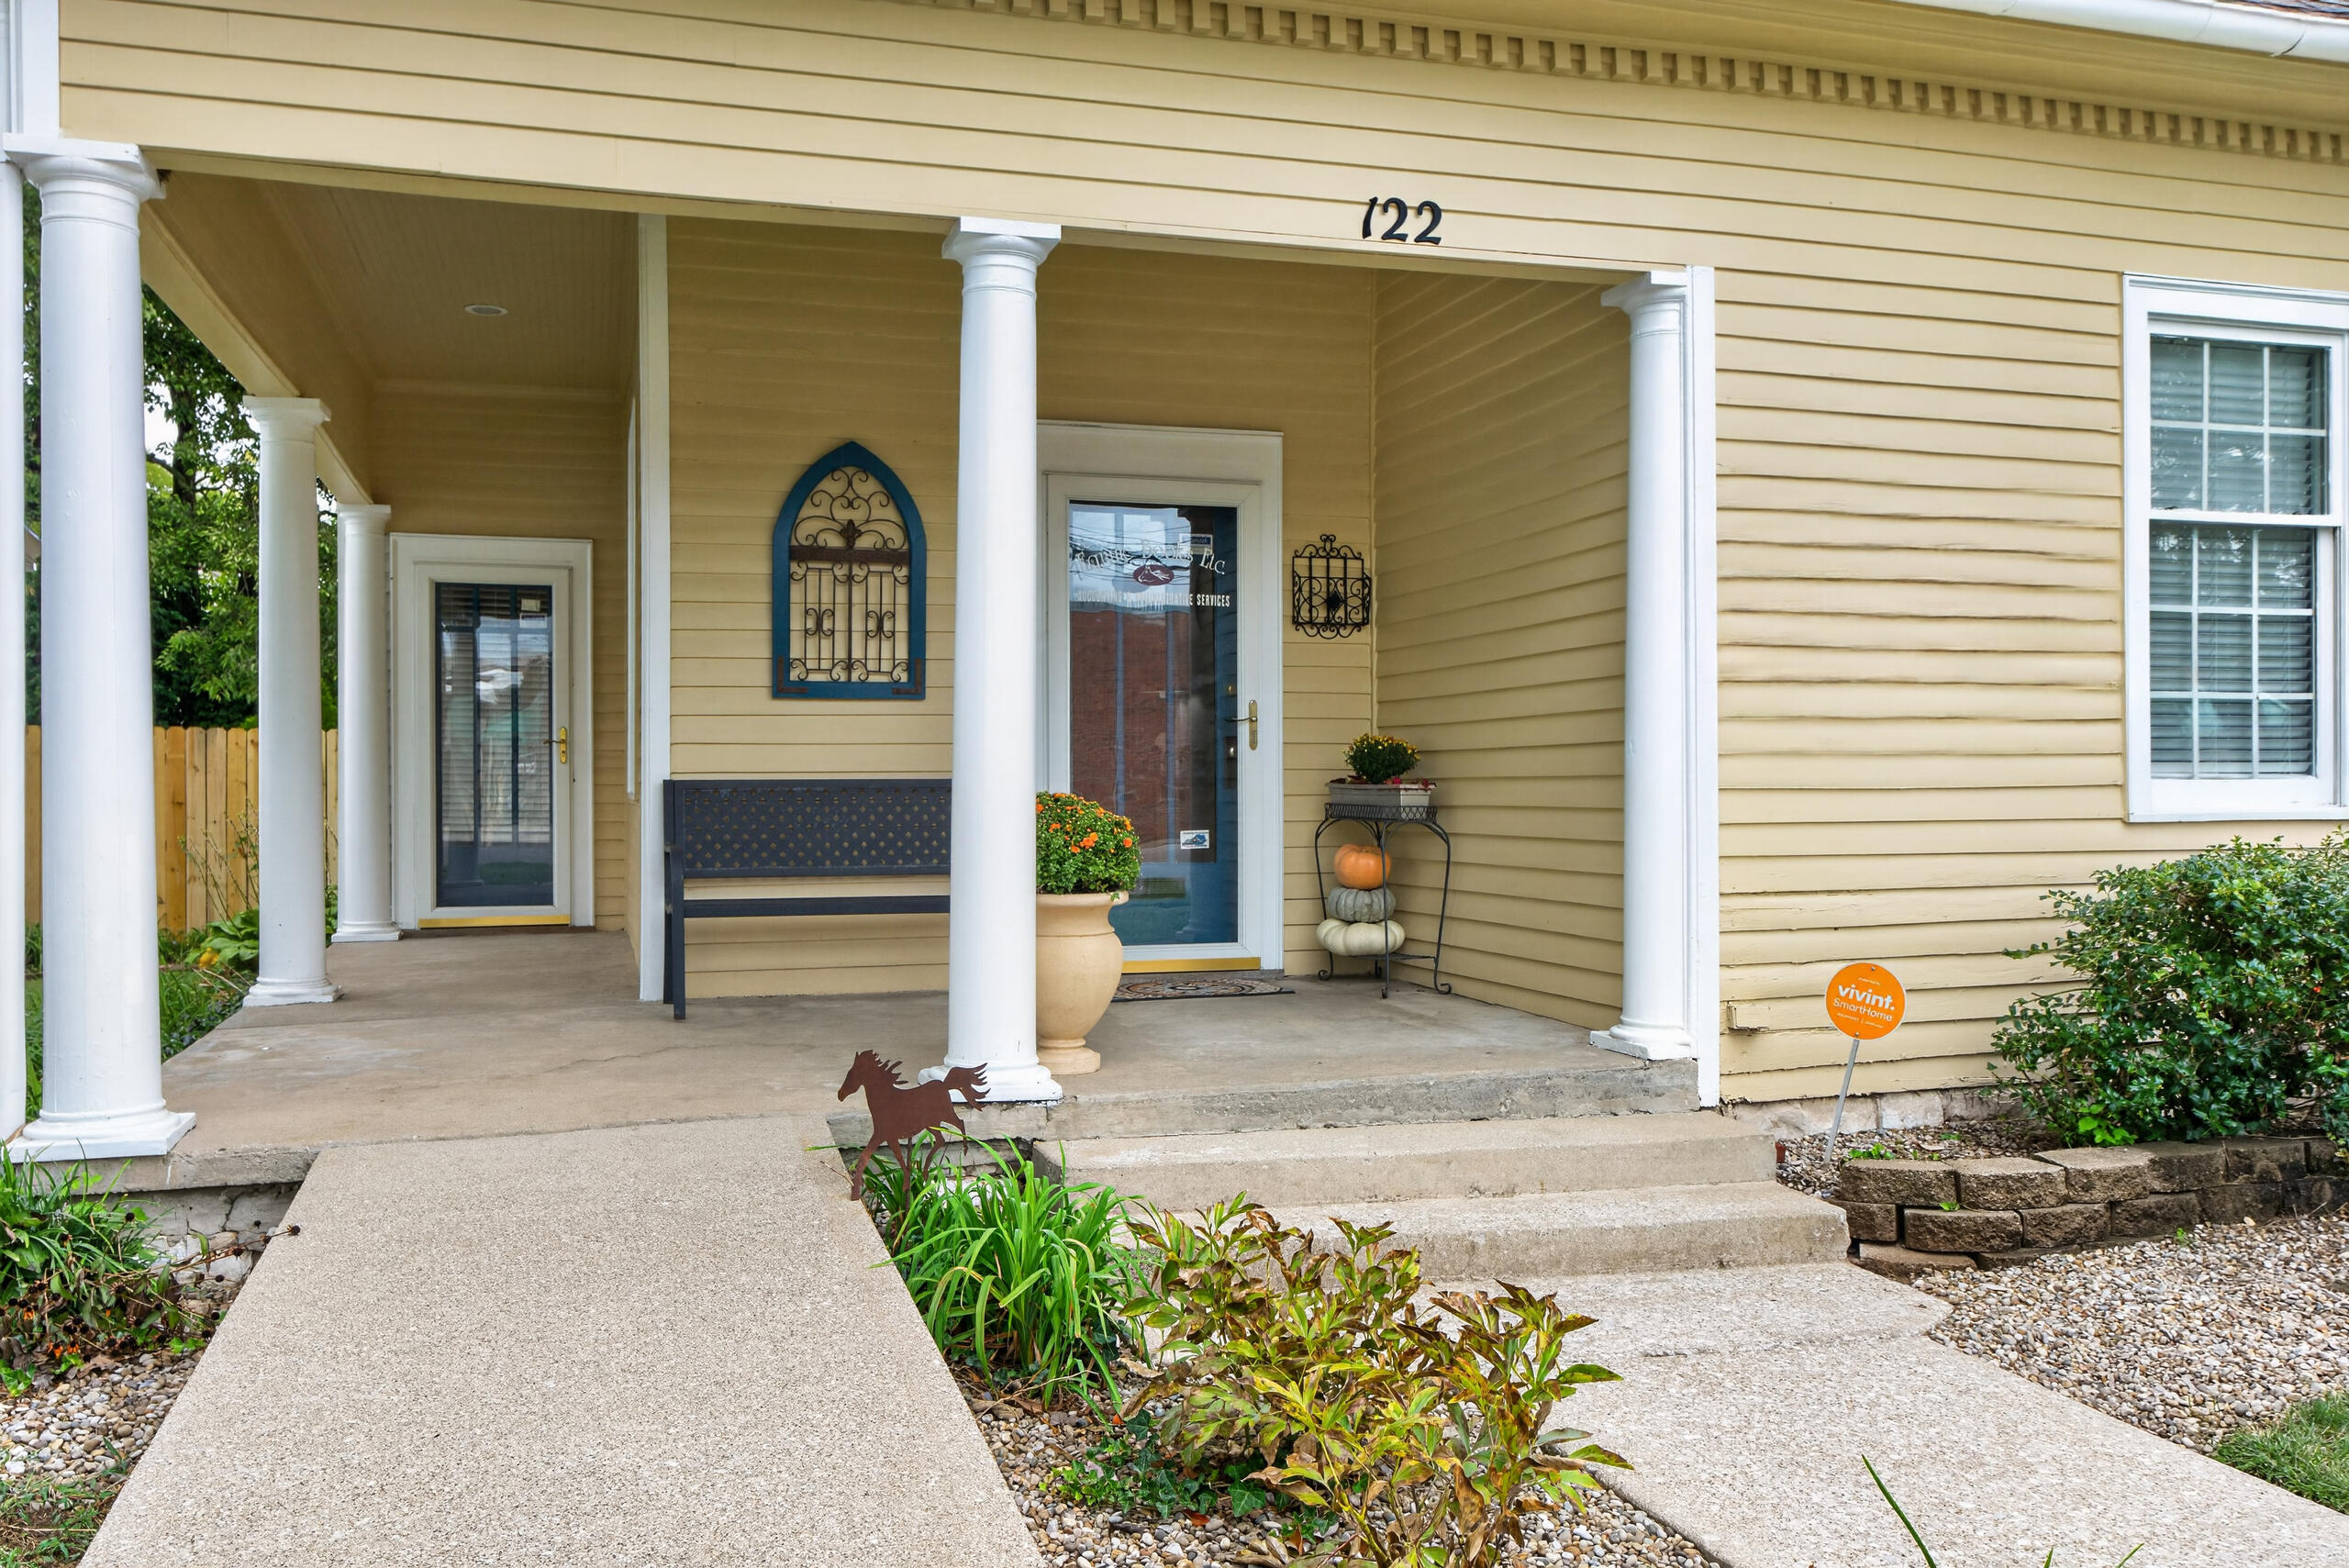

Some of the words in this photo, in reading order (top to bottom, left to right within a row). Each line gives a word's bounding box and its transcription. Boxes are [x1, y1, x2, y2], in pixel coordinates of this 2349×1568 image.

[1362, 196, 1442, 245] 122
[1197, 594, 1230, 607] SERVICES
[1838, 984, 1896, 1011] vivint.
